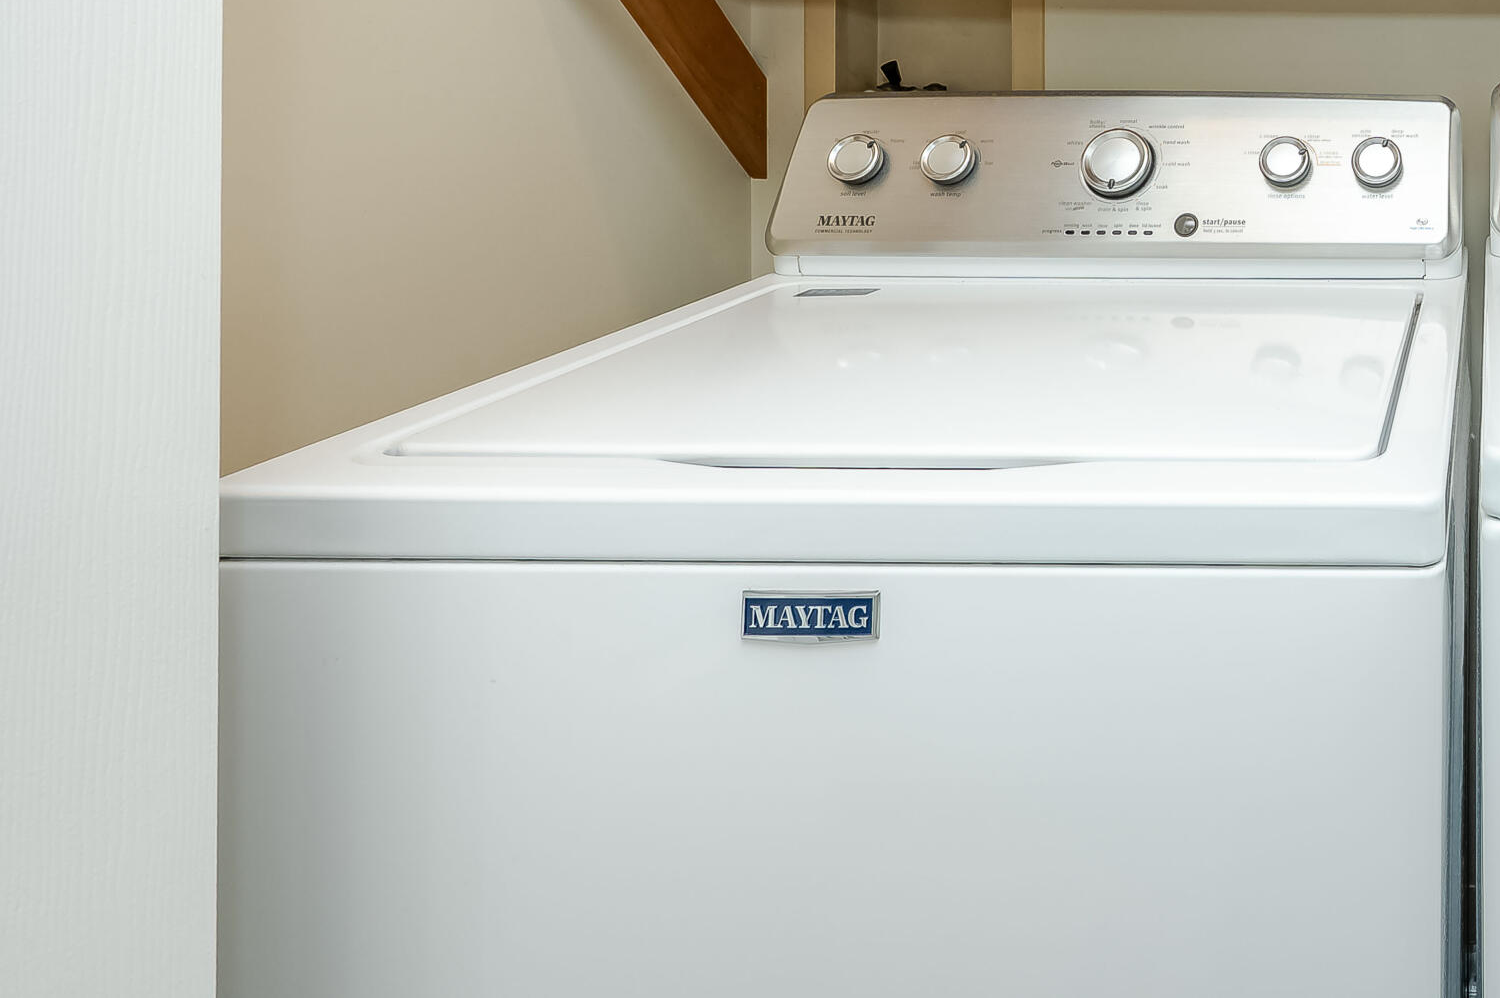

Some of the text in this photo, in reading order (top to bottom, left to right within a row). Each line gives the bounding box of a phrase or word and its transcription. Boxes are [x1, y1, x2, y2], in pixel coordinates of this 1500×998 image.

[816, 215, 876, 227] MAYTAG
[1202, 218, 1246, 227] start/pause
[749, 605, 869, 629] MAYTAG
